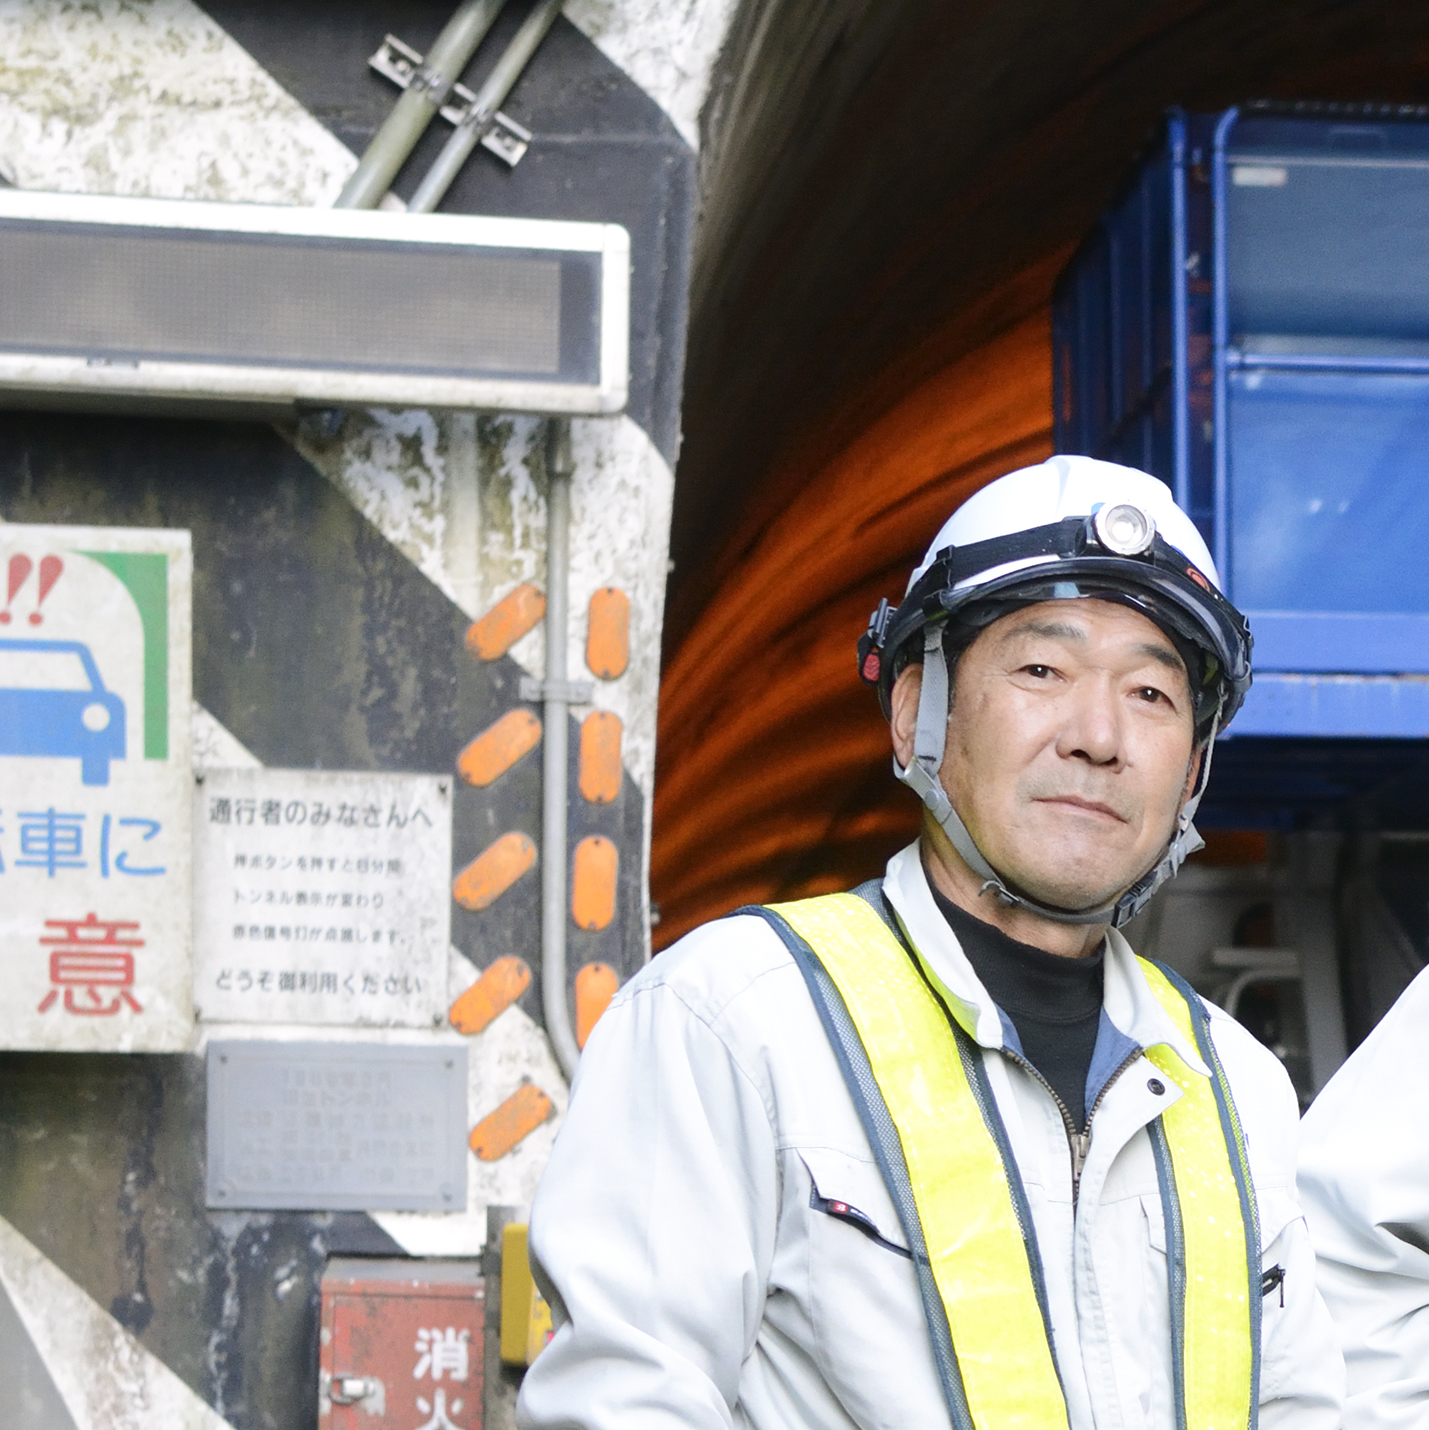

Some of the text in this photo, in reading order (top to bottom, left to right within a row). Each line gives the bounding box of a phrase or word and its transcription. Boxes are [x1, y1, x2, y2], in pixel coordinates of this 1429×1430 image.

[209, 797, 433, 829] 通行者のみなさんへ
[0, 807, 167, 879] 車に
[37, 912, 146, 1017] 意
[215, 968, 423, 996] どうぞ御利用ください
